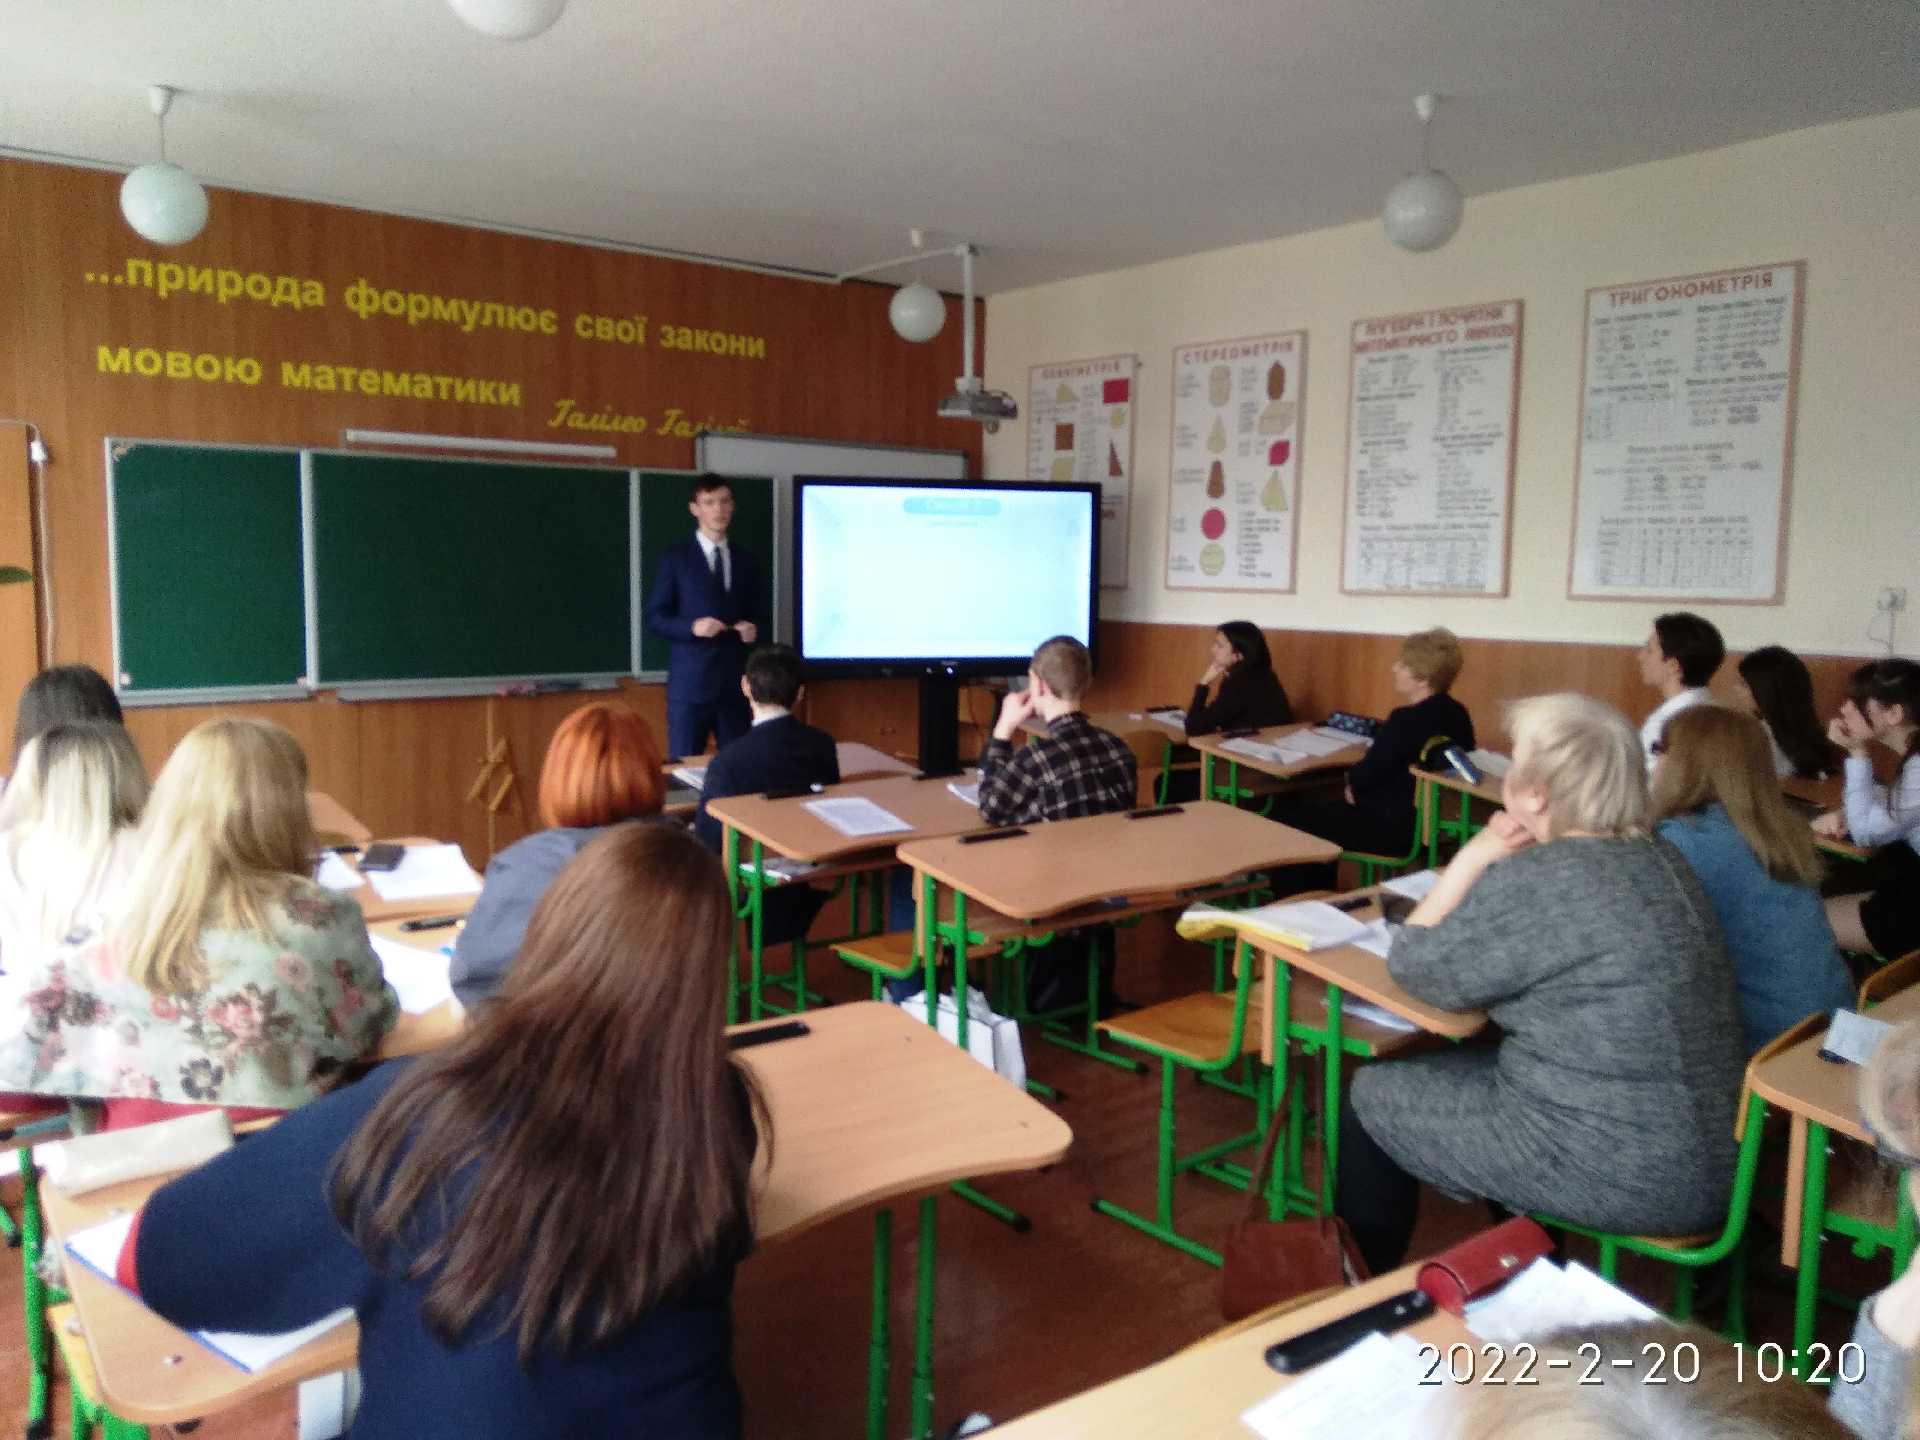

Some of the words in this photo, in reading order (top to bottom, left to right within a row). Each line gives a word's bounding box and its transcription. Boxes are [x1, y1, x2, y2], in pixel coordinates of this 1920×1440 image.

[344, 278, 559, 334] формулює
[574, 313, 648, 345] свої
[659, 324, 766, 359] закони
[1608, 270, 1773, 308] ТРИГОНОМЕТРІЯ
[96, 344, 263, 385] мовою
[280, 361, 522, 407] математики
